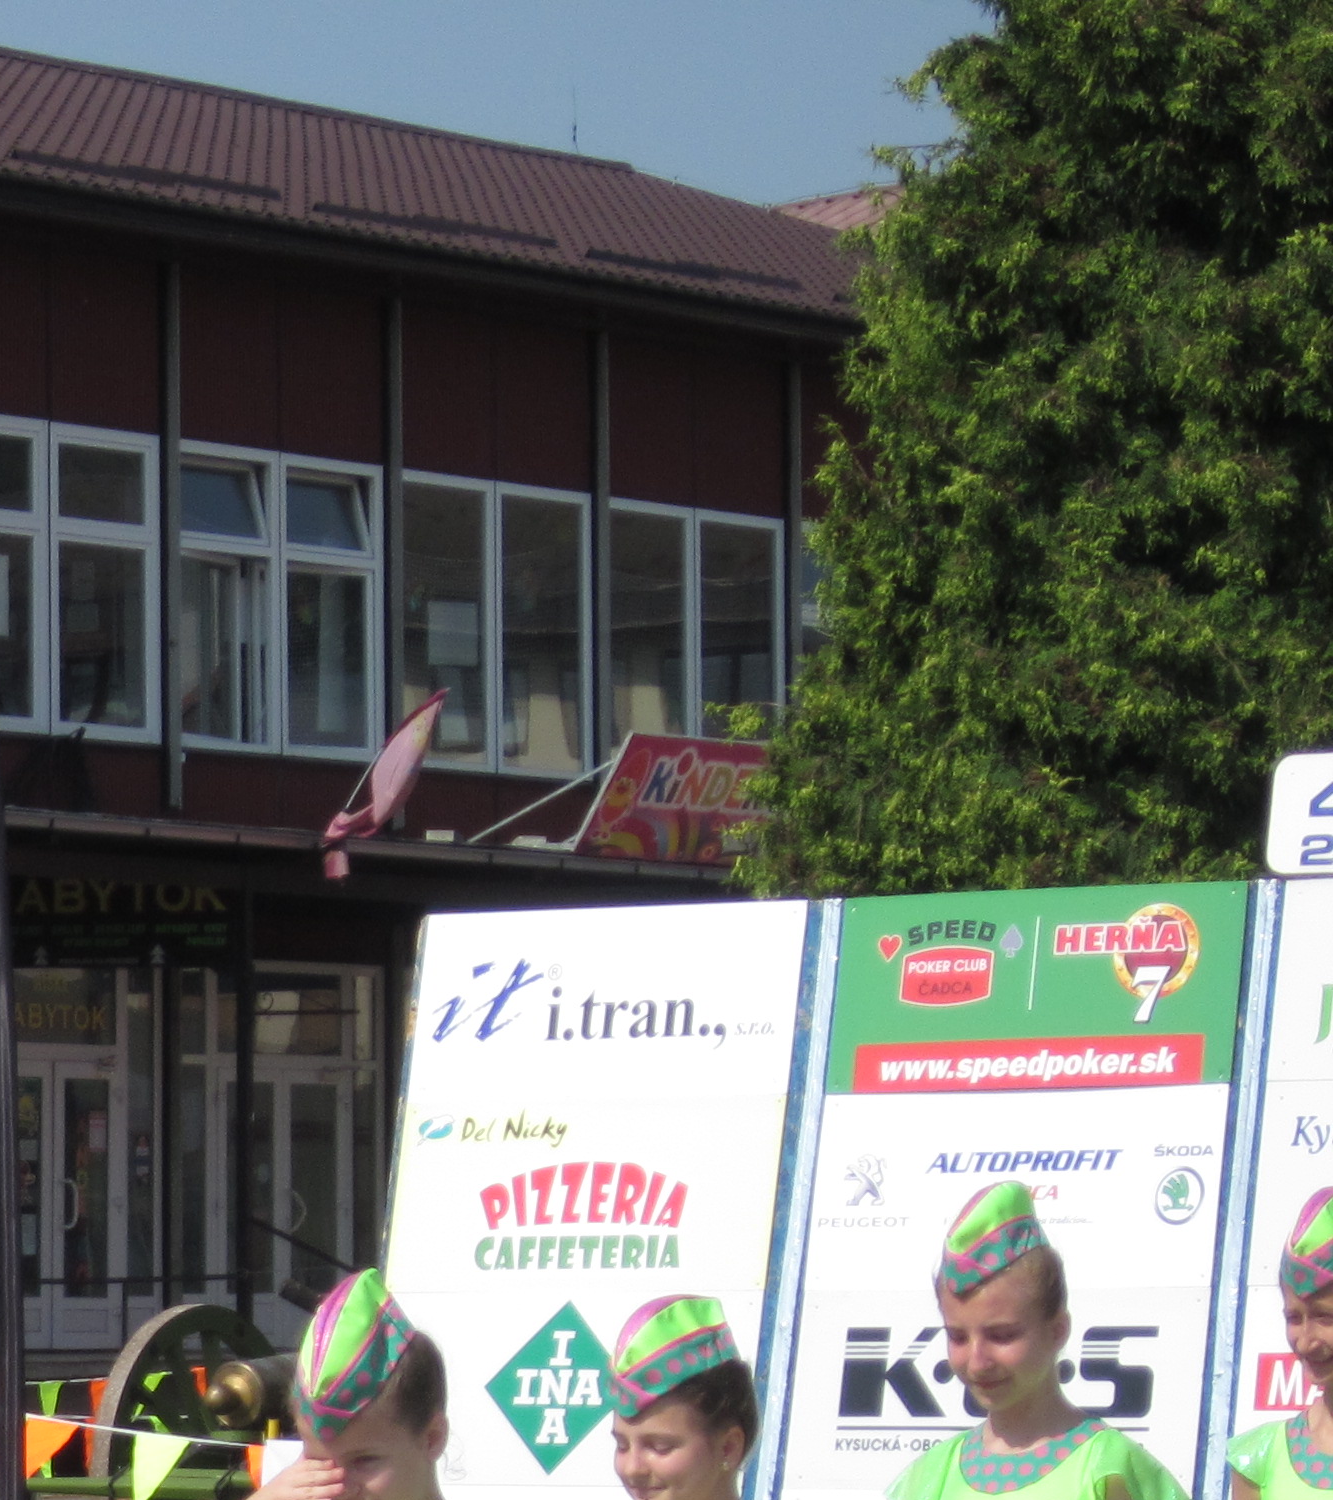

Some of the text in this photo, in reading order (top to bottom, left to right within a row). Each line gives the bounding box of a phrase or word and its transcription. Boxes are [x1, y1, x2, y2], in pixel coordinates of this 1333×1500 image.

[15, 875, 228, 914] ABYTOK
[906, 918, 997, 946] SPEED
[1053, 916, 1188, 955] HERŇA
[907, 957, 988, 975] POKER CLUB
[917, 976, 974, 997] ČADCA
[1130, 964, 1171, 1024] 7
[15, 1001, 107, 1031] ABYTOK
[878, 1046, 1178, 1083] www.speedpoker.sk
[460, 1109, 569, 1149] Del Nicky
[1290, 1115, 1333, 1156] Ky
[924, 1144, 1215, 1175] AUTOPROFIT ŠKODA
[478, 1160, 689, 1231] PIZZERIA
[817, 1215, 911, 1229] PEUGEOT
[473, 1234, 681, 1272] CAFFETERIA
